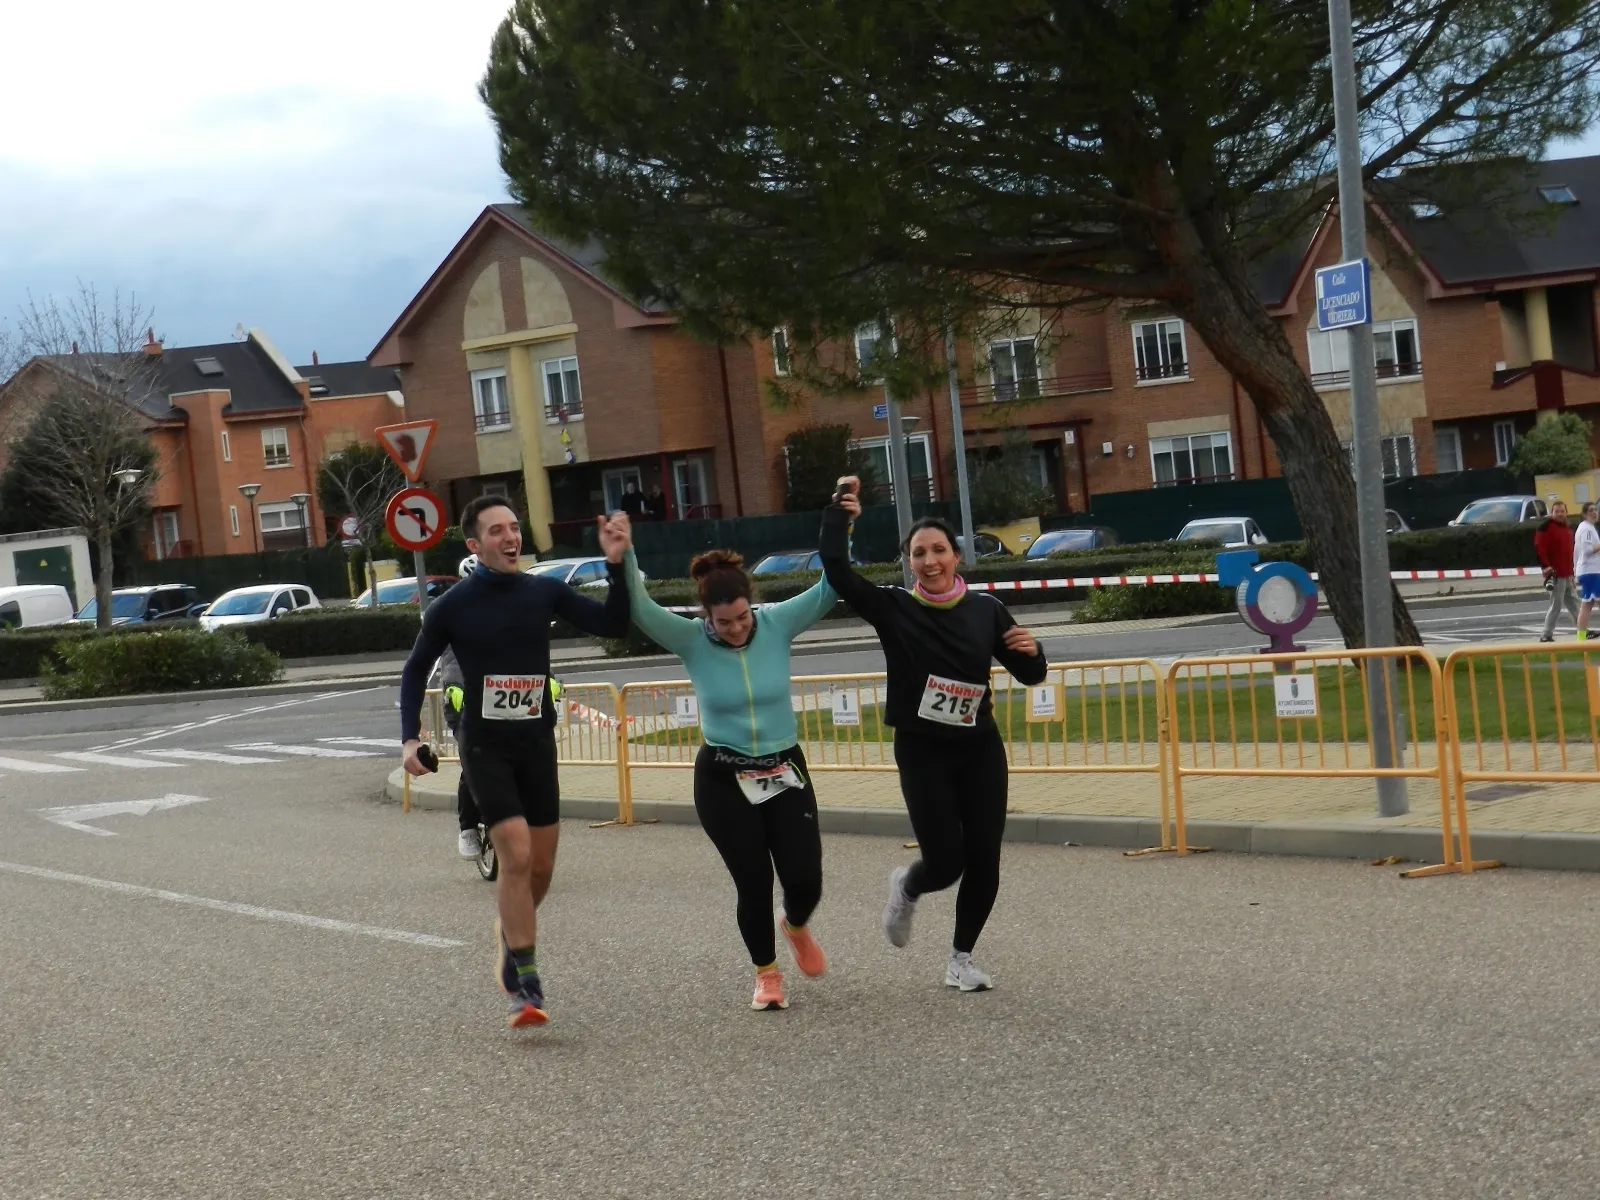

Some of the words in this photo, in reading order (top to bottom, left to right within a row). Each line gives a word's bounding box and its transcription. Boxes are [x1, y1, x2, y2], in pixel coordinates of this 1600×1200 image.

[1322, 292, 1360, 309] LICENCIADO
[494, 690, 533, 709] 204
[931, 692, 972, 715] 215
